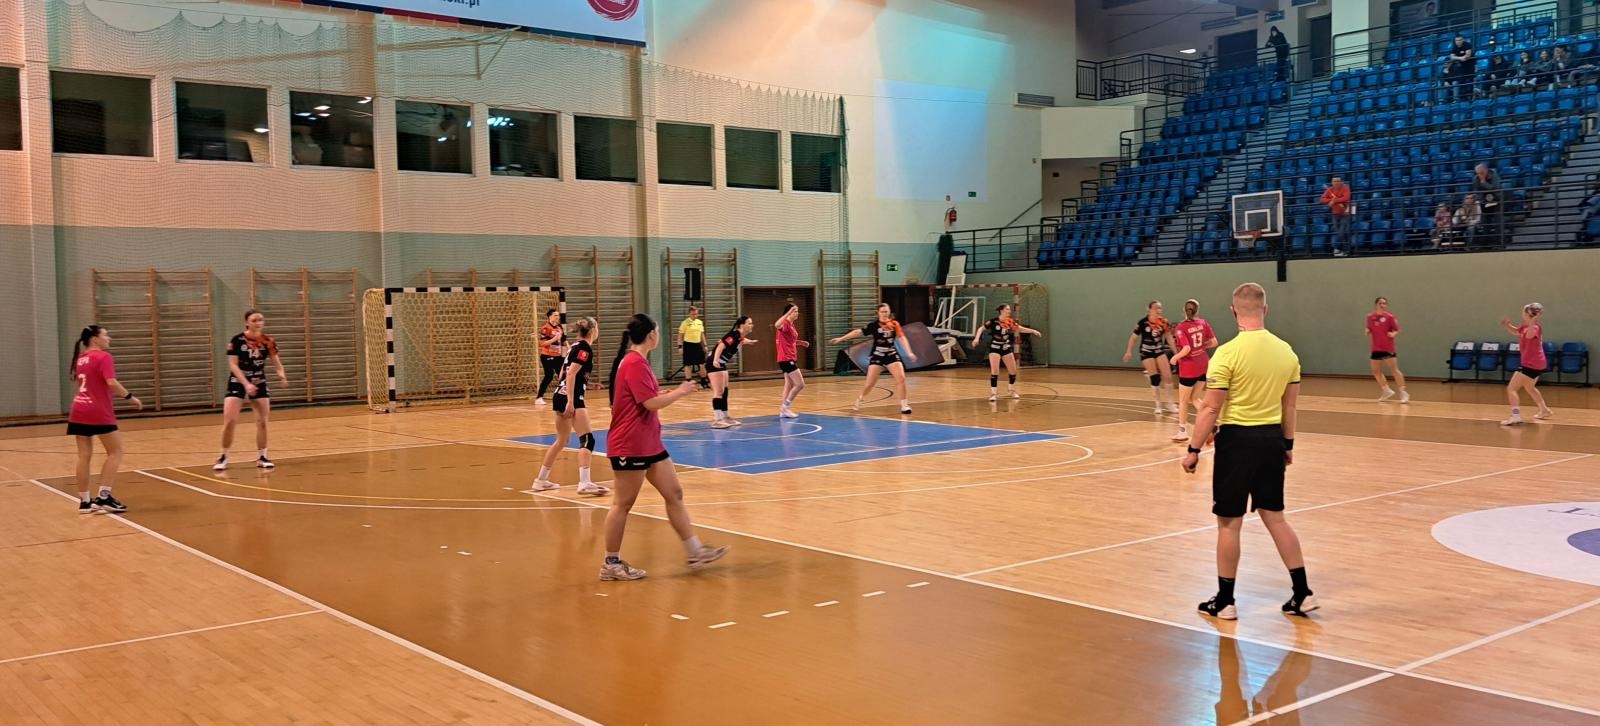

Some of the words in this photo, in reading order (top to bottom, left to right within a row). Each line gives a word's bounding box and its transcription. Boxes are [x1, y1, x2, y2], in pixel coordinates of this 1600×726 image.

[1191, 332, 1203, 348] 13
[247, 349, 260, 358] 14
[78, 373, 87, 392] 2
